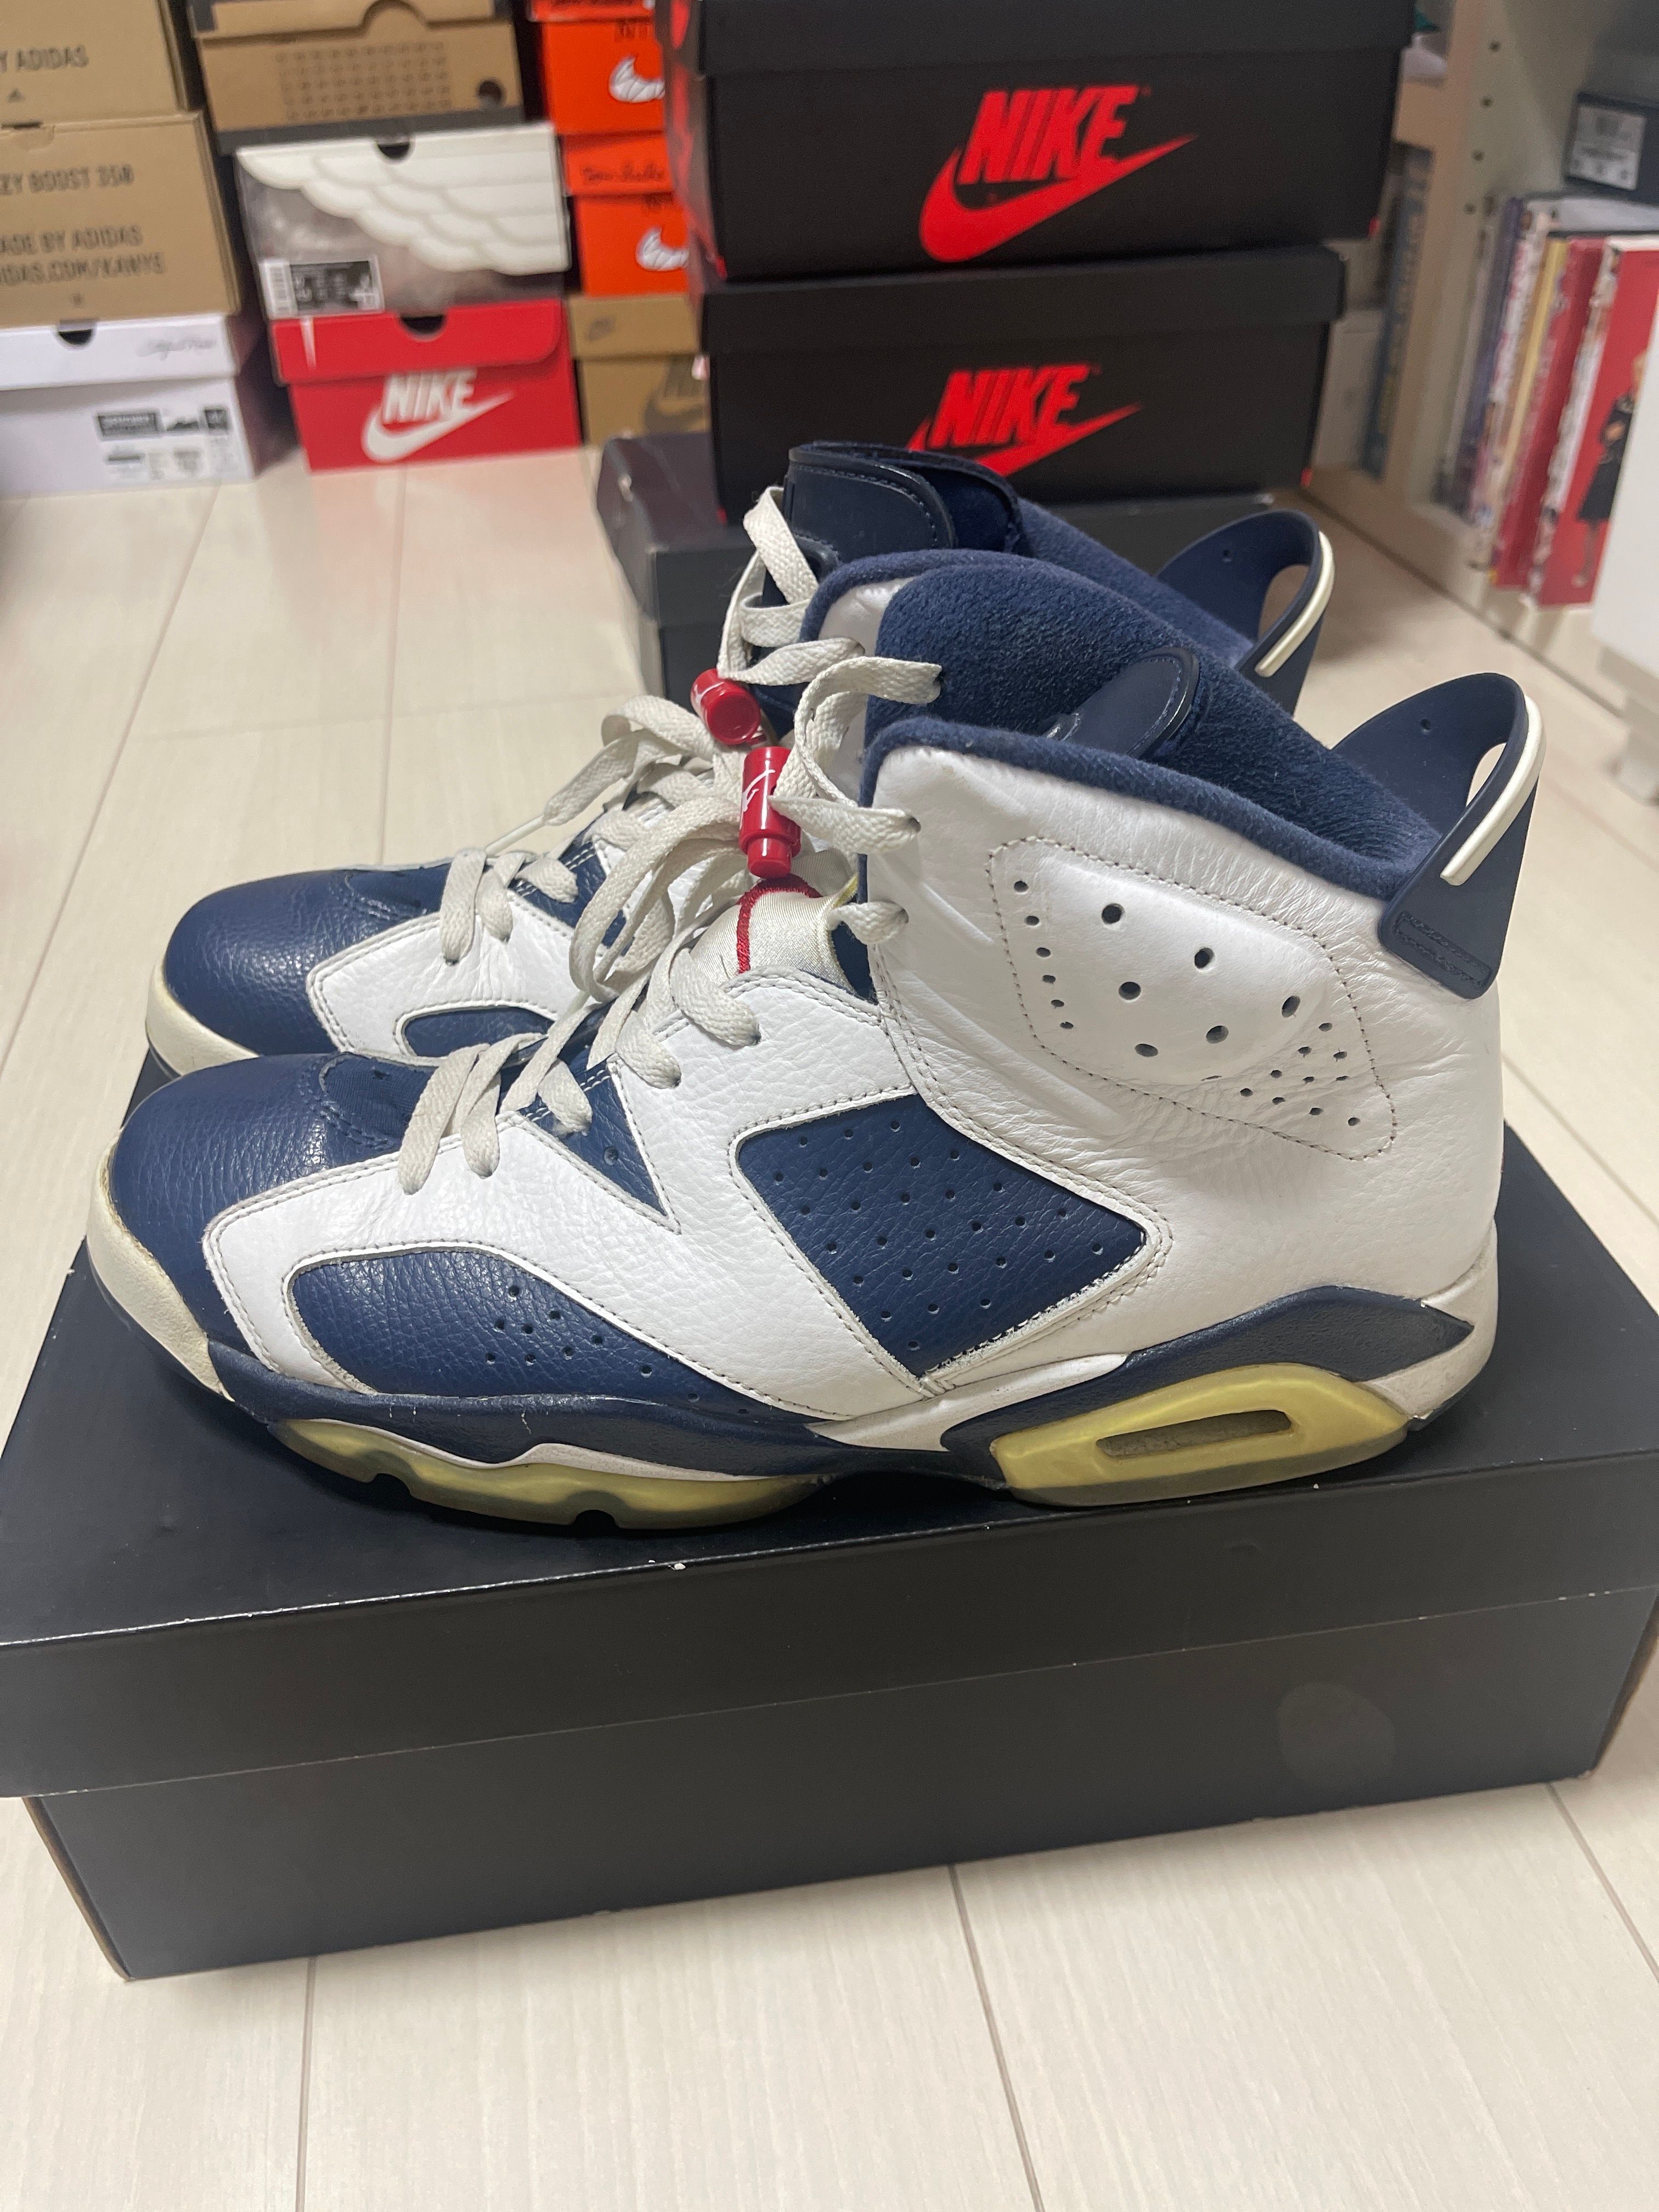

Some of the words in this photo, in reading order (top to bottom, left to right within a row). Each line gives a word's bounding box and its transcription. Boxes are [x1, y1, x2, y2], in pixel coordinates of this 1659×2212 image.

[15, 44, 89, 72] ADIDAS
[958, 85, 1139, 185] NIKE
[29, 166, 89, 193] BOOST
[97, 163, 134, 188] 350
[40, 230, 65, 252] BY
[71, 225, 143, 251] ADIDAS
[0, 252, 165, 285] IDAS.COM/KANYE
[383, 369, 477, 422] NIKE
[927, 363, 1091, 448] NIKE
